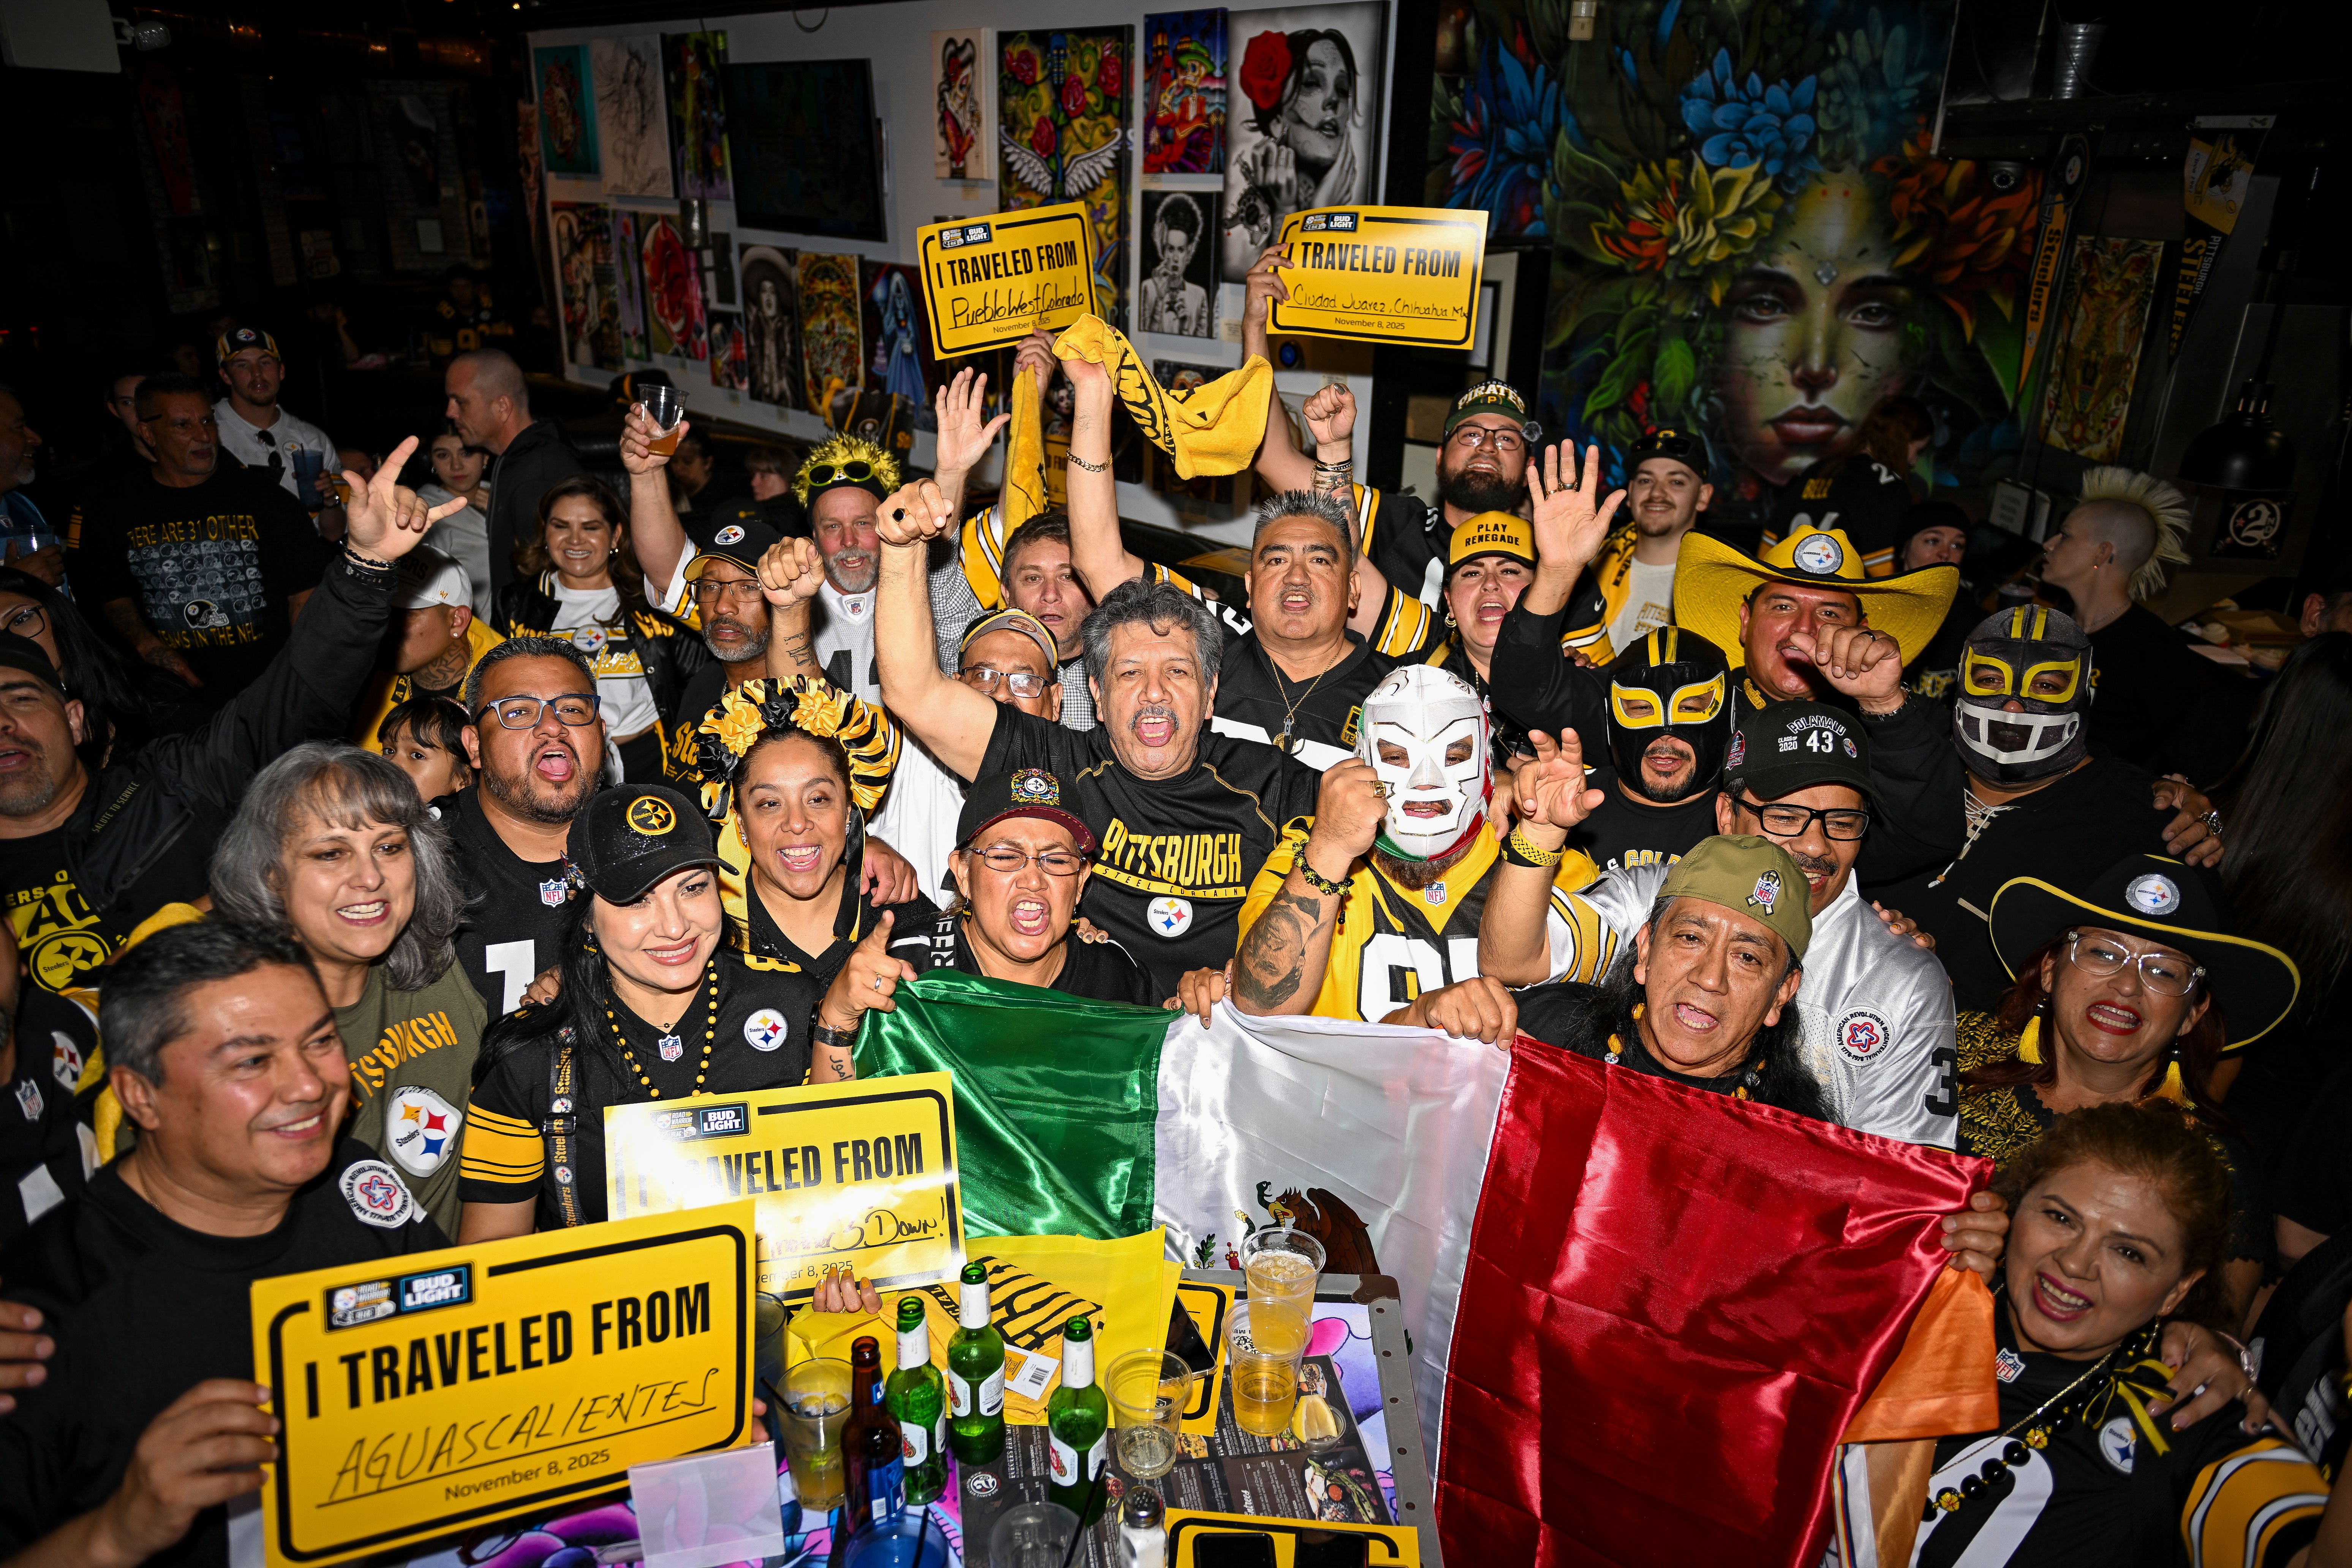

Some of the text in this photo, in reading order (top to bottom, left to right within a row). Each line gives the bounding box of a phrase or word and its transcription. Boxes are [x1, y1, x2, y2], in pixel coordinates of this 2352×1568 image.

[967, 234, 988, 243] LIGHT
[969, 227, 984, 236] BUD
[936, 240, 1078, 289] I TRAVELED FROM
[1287, 242, 1461, 278] I TRAVELED FROM
[2193, 234, 2221, 296] PITTSBURGH
[2030, 226, 2062, 323] Steelers
[1293, 283, 1338, 308] Ciudad
[1394, 297, 1448, 317] Chihuahua
[2169, 236, 2205, 357] STEELERS
[993, 322, 1031, 333] November
[1037, 316, 1051, 326] 2025
[1335, 317, 1375, 327] November
[1377, 321, 1384, 329] 8,
[1458, 384, 1525, 414] PIRATES
[1487, 395, 1497, 404] P
[161, 520, 185, 542] ARE
[189, 518, 202, 540] 31
[207, 514, 260, 542] OTHER
[1477, 523, 1508, 533] PLAY
[1465, 533, 1520, 547] RENEGADE
[193, 629, 208, 648] IN
[210, 626, 236, 646] THE
[1786, 716, 1846, 736] POLAMALU
[1778, 741, 1798, 753] 2020
[1806, 730, 1834, 753] 43
[91, 780, 141, 834] SALUTE TO SERVICE
[633, 812, 653, 820] Steelers
[1100, 817, 1241, 885] PITTSBURGH
[1101, 868, 1238, 898] STEEL CURTAIN
[545, 890, 563, 902] NFL
[1428, 890, 1444, 901] NFL
[1758, 888, 1772, 901] NFL
[42, 960, 69, 973] Steelers
[1837, 1011, 1891, 1062] AMERICAN REVOLUTION BICENTENNIAL
[664, 1045, 680, 1057] NFL
[671, 1117, 692, 1125] WARRIOR
[707, 1110, 734, 1122] BUD
[395, 1129, 420, 1147] Steelers
[553, 1118, 567, 1163] Steelers
[833, 1132, 924, 1184] FROM
[561, 1186, 577, 1228] Steelers
[412, 1273, 455, 1292] BUD
[756, 1260, 853, 1283] vember 8, 2025
[405, 1285, 462, 1307] LIGHT
[305, 1282, 710, 1420] I TRAVELED FROM
[1996, 1358, 2011, 1379] NFL
[329, 1367, 720, 1503] AGUASCALIENTES
[2108, 1428, 2129, 1443] Steelers
[445, 1448, 610, 1500] November 8, 2025
[1007, 1451, 1015, 1478] BURGERS
